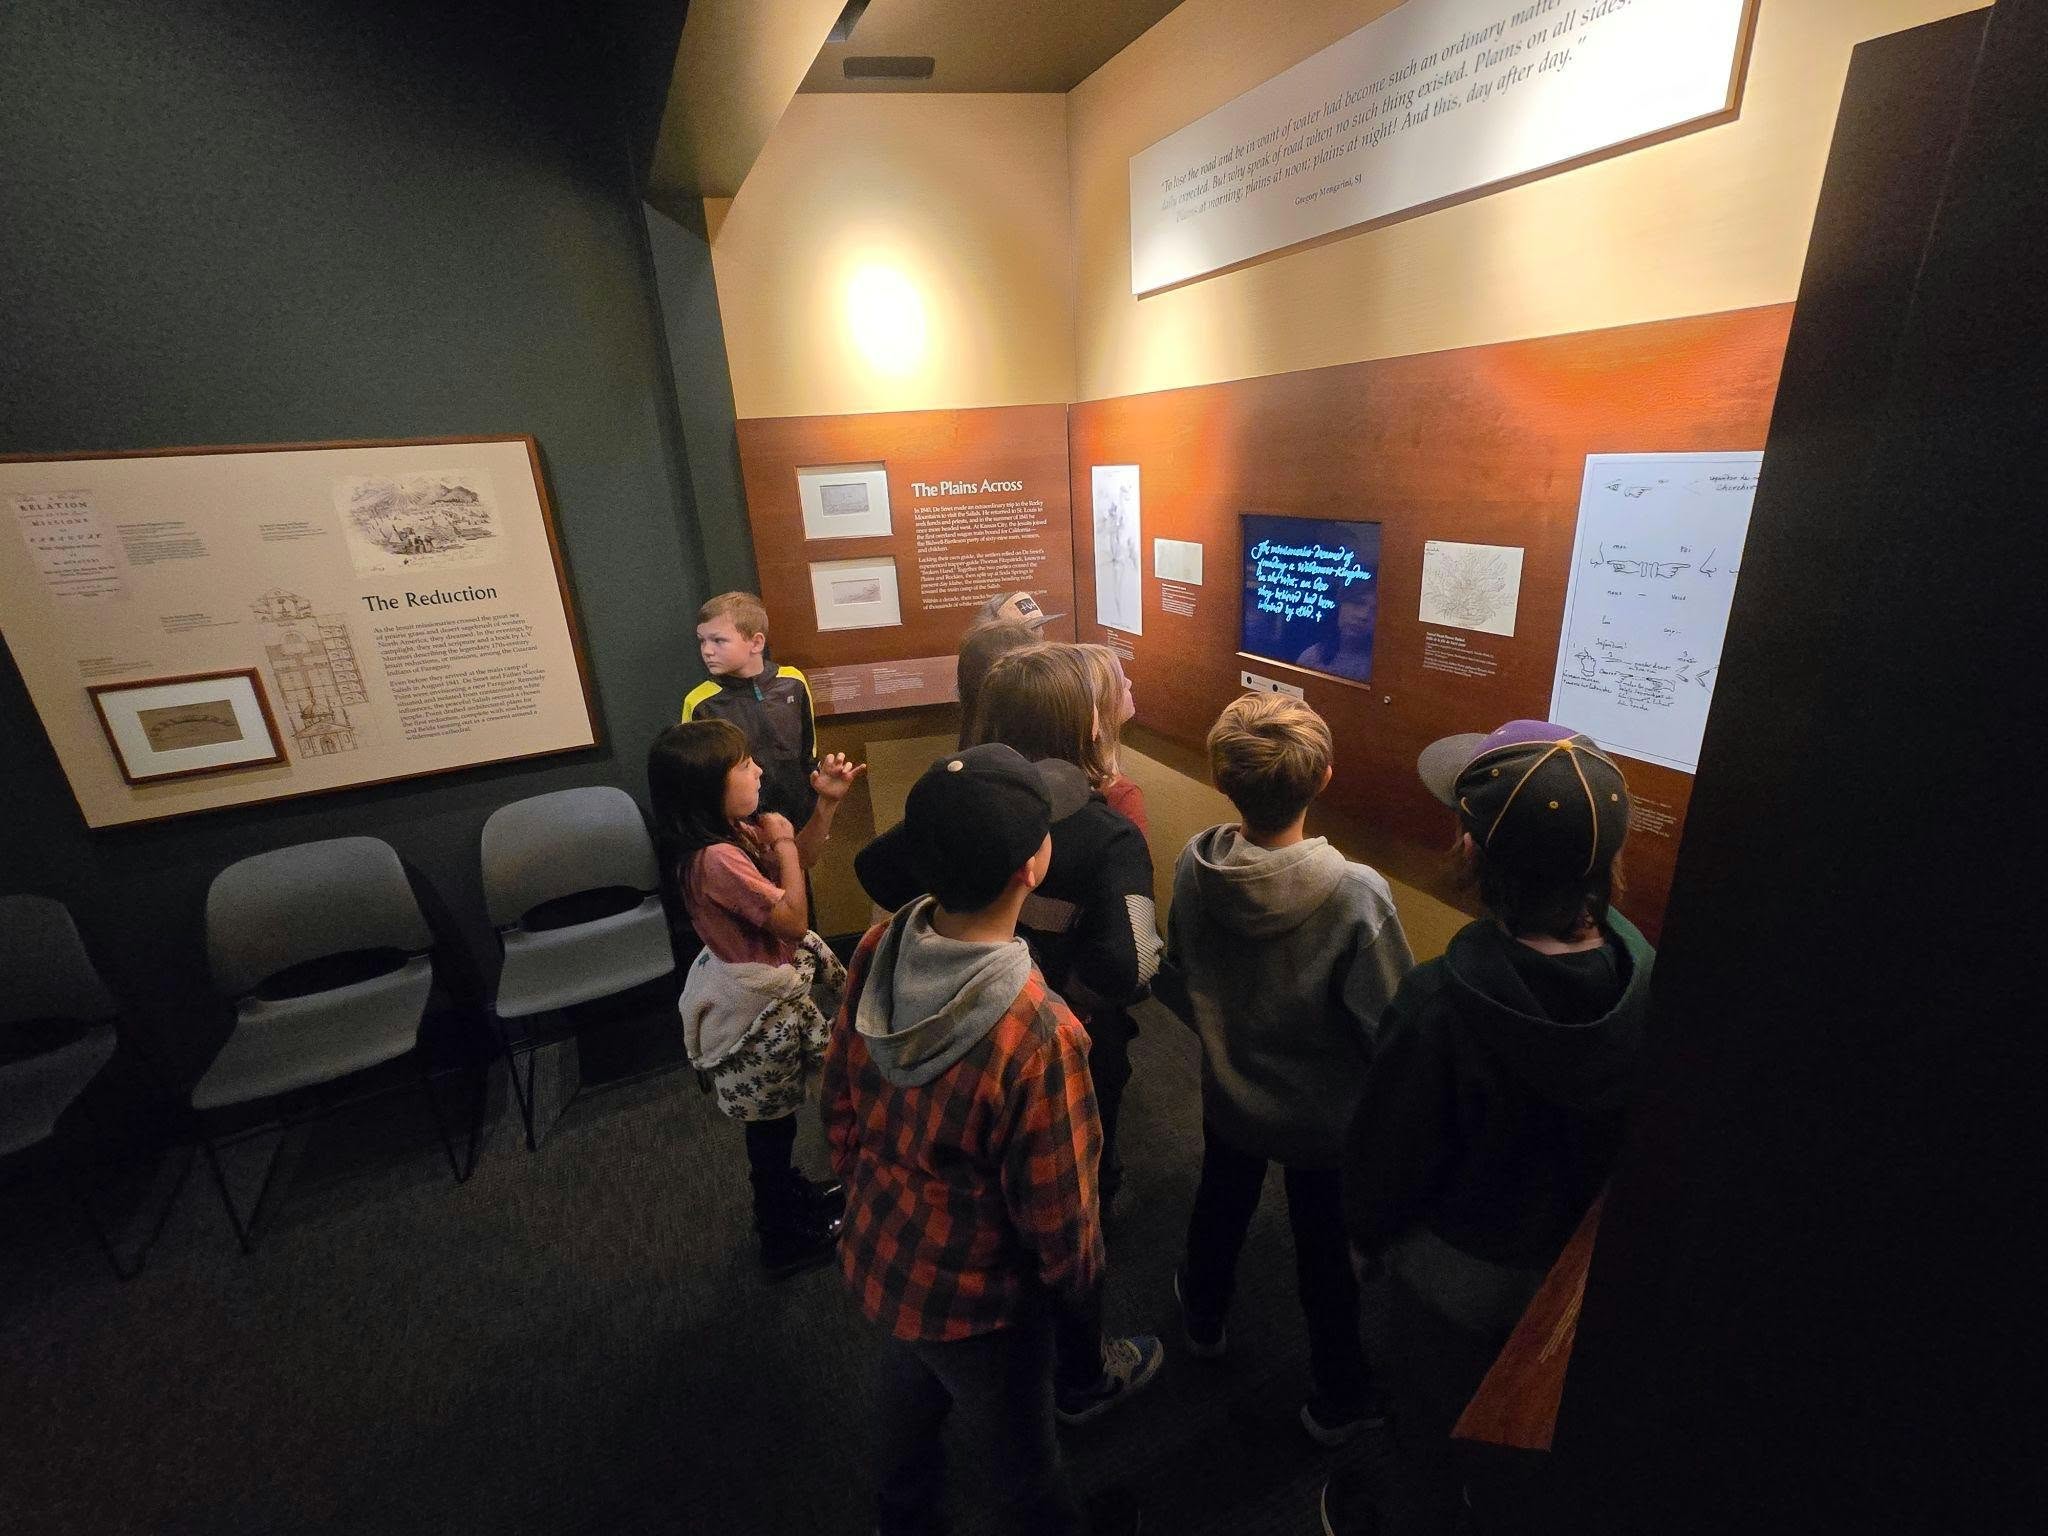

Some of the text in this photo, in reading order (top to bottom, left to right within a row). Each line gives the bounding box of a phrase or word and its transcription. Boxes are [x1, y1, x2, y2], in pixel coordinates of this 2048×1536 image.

[1172, 174, 1186, 187] lose
[1186, 166, 1198, 181] the
[1199, 156, 1215, 175] road
[1218, 148, 1231, 166] and
[1235, 144, 1243, 158] be
[1246, 138, 1254, 153] in
[1257, 125, 1278, 148] want
[1282, 118, 1291, 139] of
[1294, 108, 1321, 131] water
[1323, 93, 1342, 117] had
[1344, 76, 1385, 106] become
[1388, 55, 1418, 85] such
[1420, 51, 1436, 70] an
[1442, 17, 1505, 60] ordinary
[1199, 200, 1206, 213] at
[1246, 176, 1270, 198] plains
[1273, 168, 1282, 183] at
[1314, 145, 1343, 171] plains
[1347, 135, 1357, 152] at
[1362, 117, 1397, 147] night!
[1401, 103, 1431, 130] And
[1434, 92, 1462, 116] this,
[1466, 82, 1491, 103] day
[1496, 64, 1532, 94] after
[1212, 172, 1225, 189] But
[1228, 164, 1246, 182] why
[1247, 151, 1268, 177] speak
[1272, 146, 1280, 166] of
[1284, 135, 1303, 157] road
[1307, 127, 1332, 147] when
[1336, 119, 1348, 134] no
[1352, 102, 1376, 127] such
[1382, 89, 1414, 114] thing
[1417, 60, 1466, 98] existed.
[1474, 40, 1521, 73] Plains
[1526, 28, 1547, 49] on
[1552, 9, 1576, 38] all
[1294, 190, 1319, 206] Gregory
[911, 479, 1023, 497] The Plains Across
[362, 586, 498, 612] The Reduction
